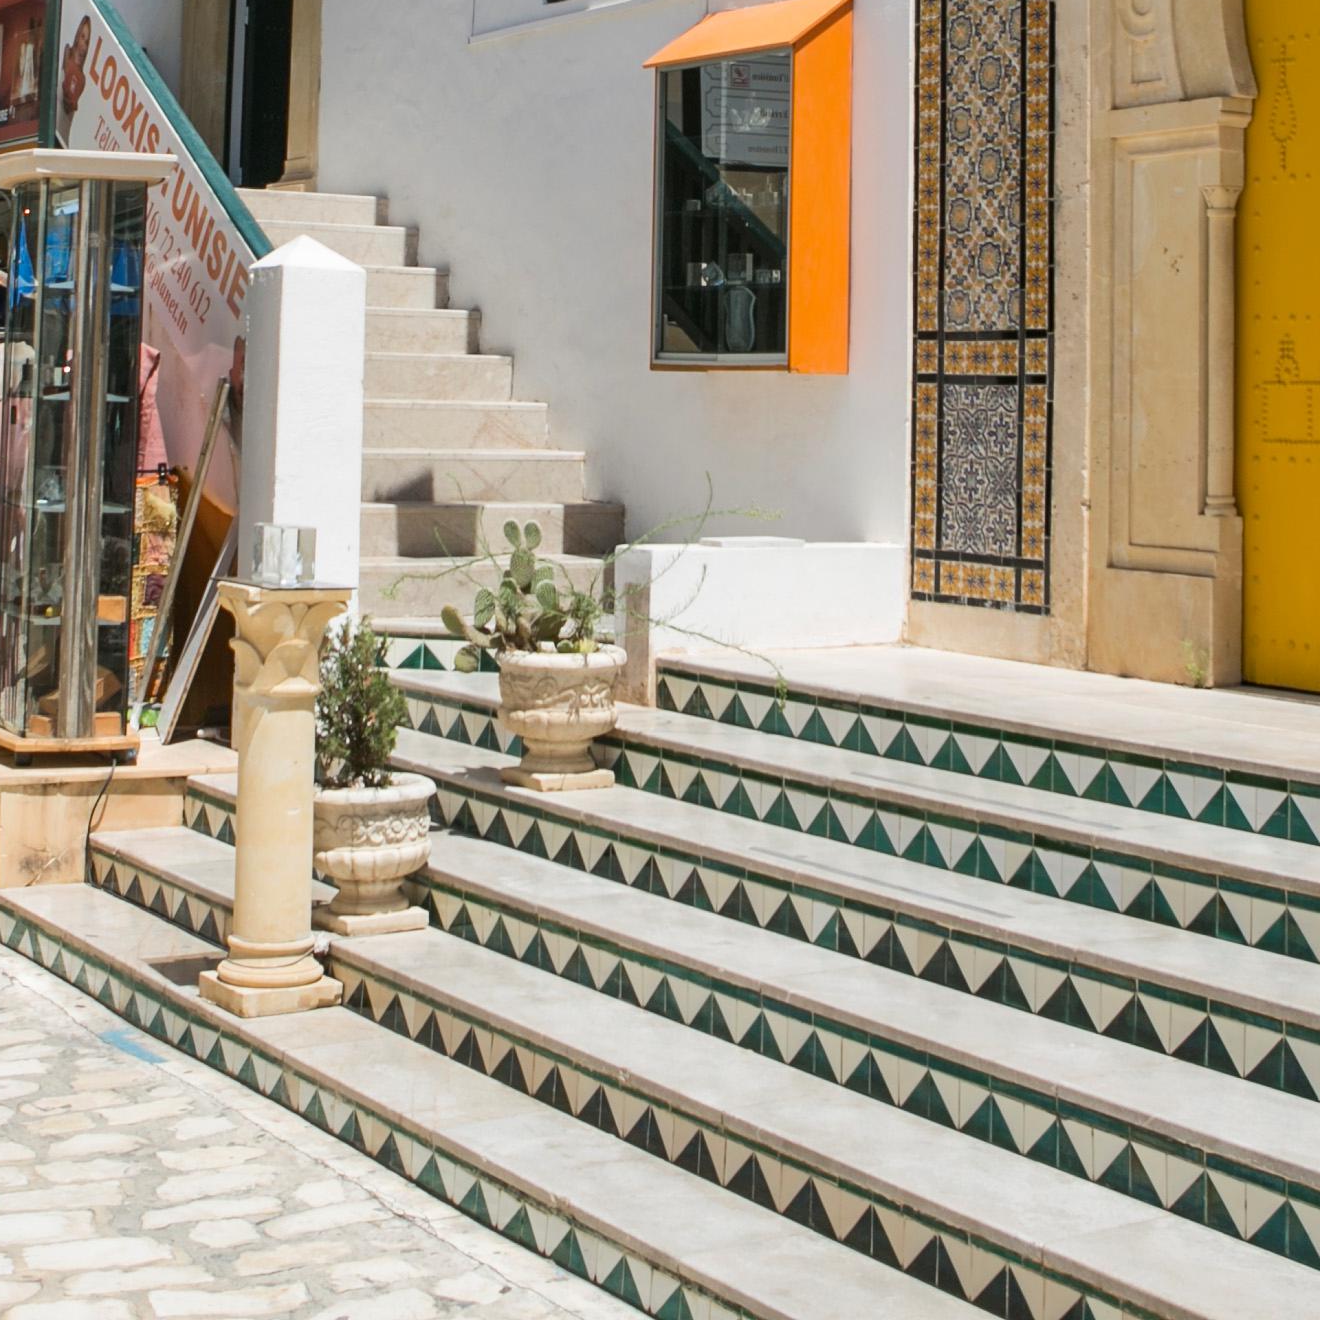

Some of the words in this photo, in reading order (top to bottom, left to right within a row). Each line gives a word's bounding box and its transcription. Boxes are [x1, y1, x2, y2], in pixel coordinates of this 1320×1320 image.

[89, 36, 160, 154] LOOXIS
[159, 226, 175, 262] 72
[170, 247, 192, 293] 240
[189, 280, 211, 325] 612
